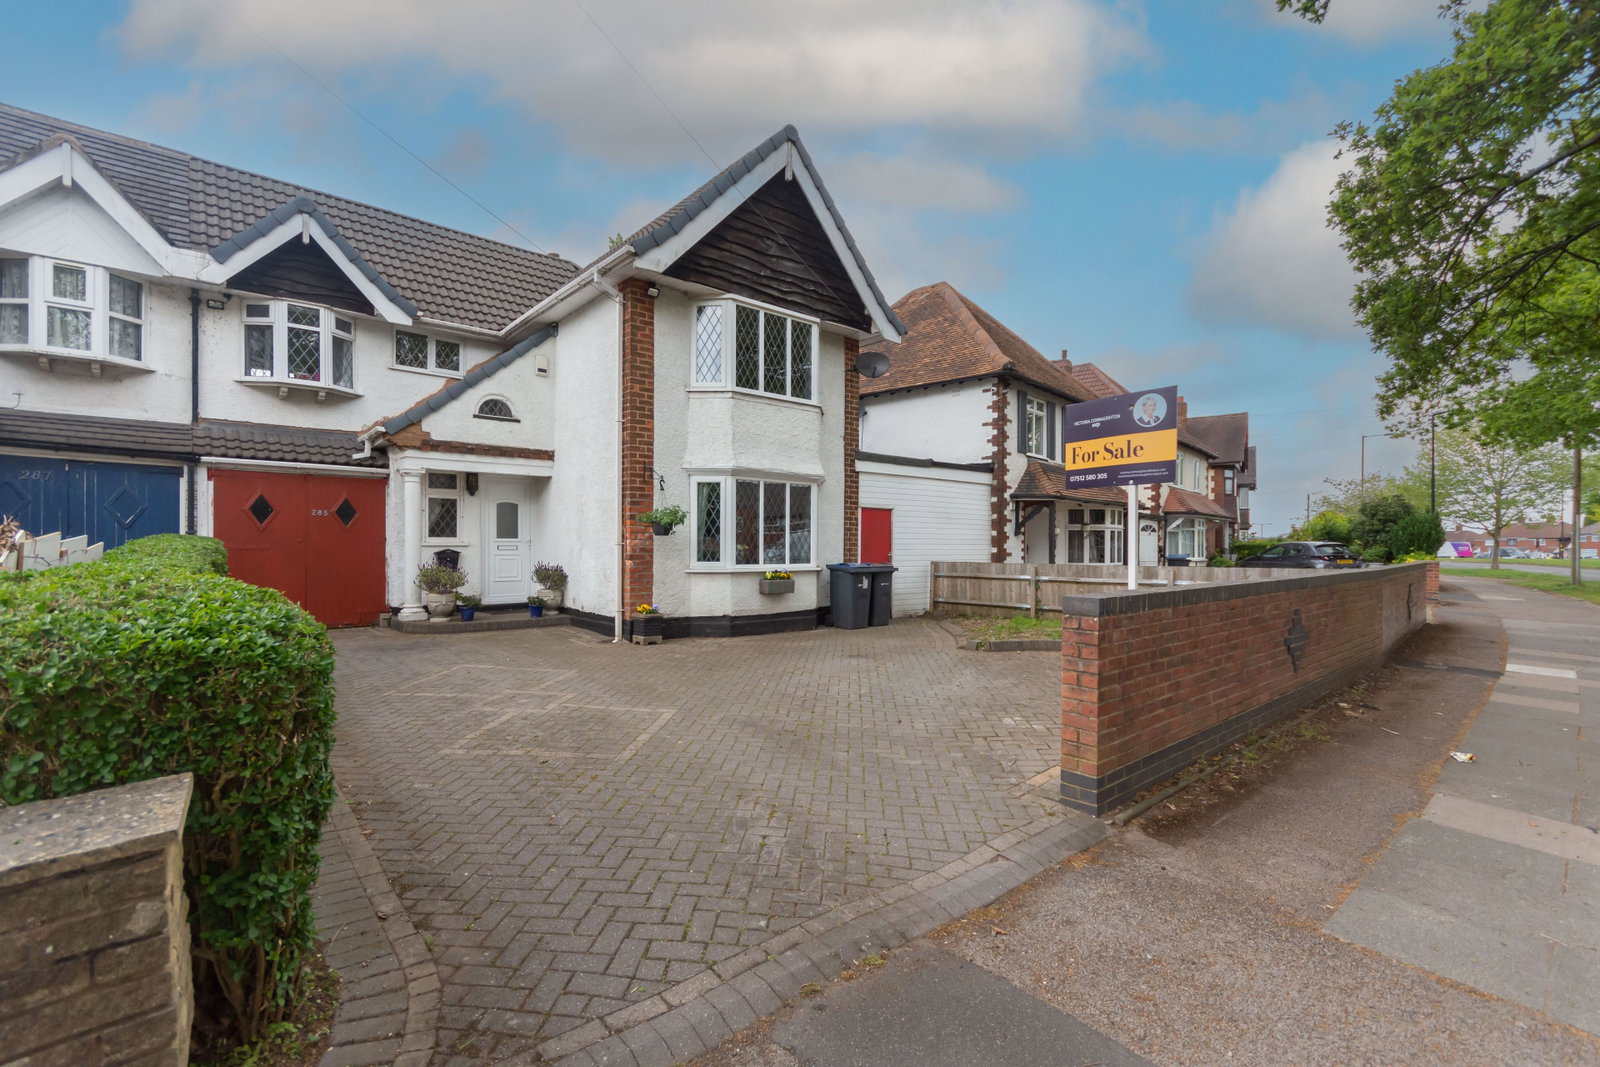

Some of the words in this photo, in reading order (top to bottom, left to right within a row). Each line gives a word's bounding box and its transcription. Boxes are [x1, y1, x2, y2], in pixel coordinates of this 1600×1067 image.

[1072, 446, 1100, 464] For
[1103, 439, 1144, 461] Sale
[18, 470, 52, 481] 287
[1097, 472, 1108, 480] 305
[311, 509, 329, 517] 285
